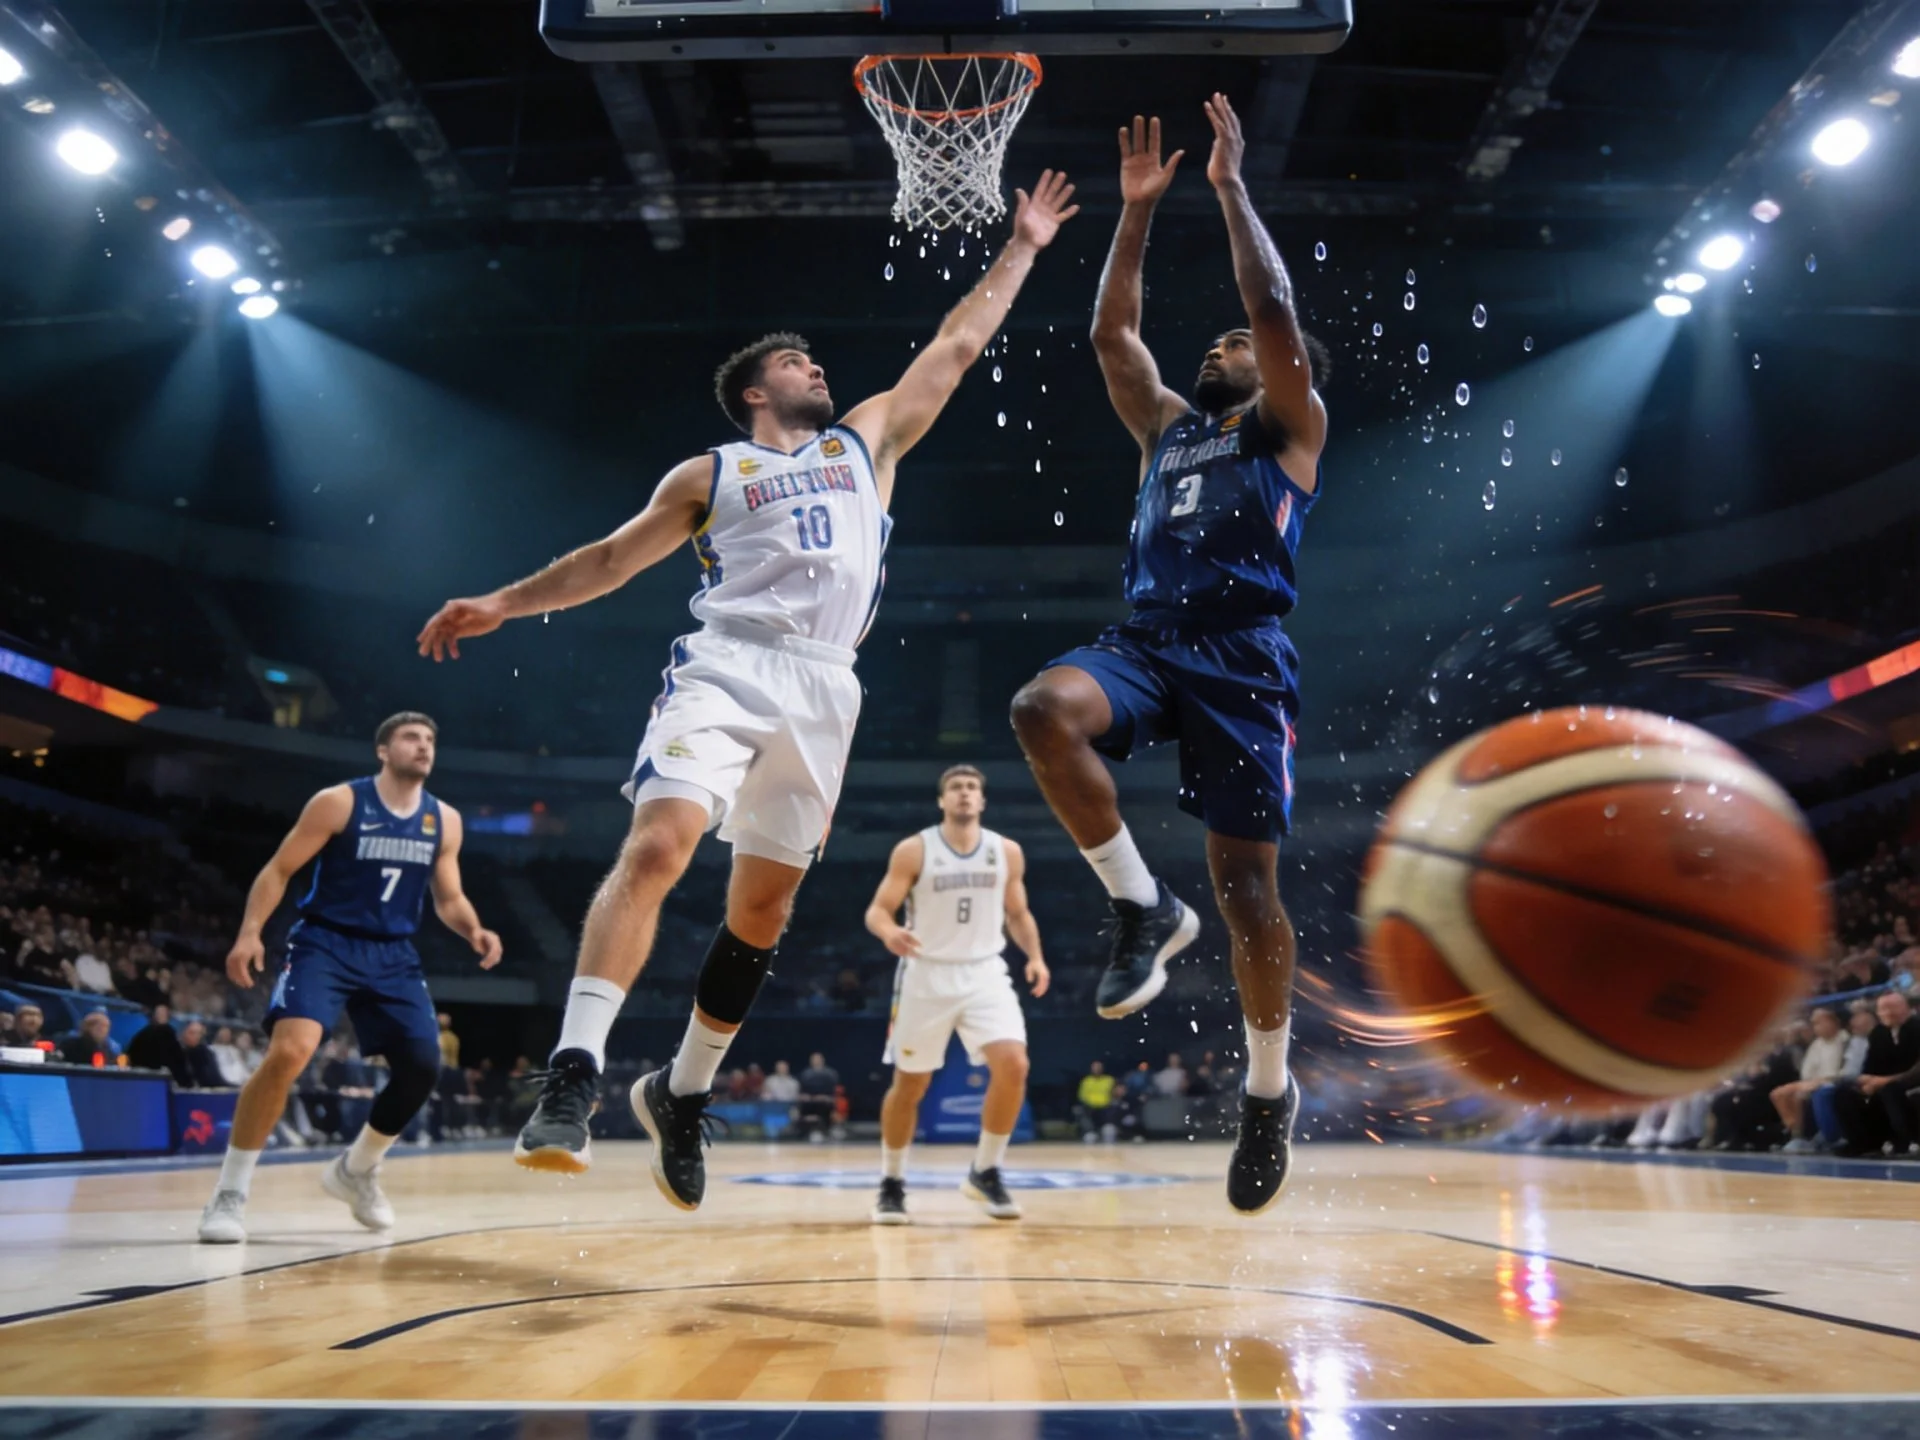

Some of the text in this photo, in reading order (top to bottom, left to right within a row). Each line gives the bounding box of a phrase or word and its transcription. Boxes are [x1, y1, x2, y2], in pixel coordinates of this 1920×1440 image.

[1170, 473, 1203, 518] 3
[791, 504, 832, 551] 10
[380, 867, 403, 902] 7
